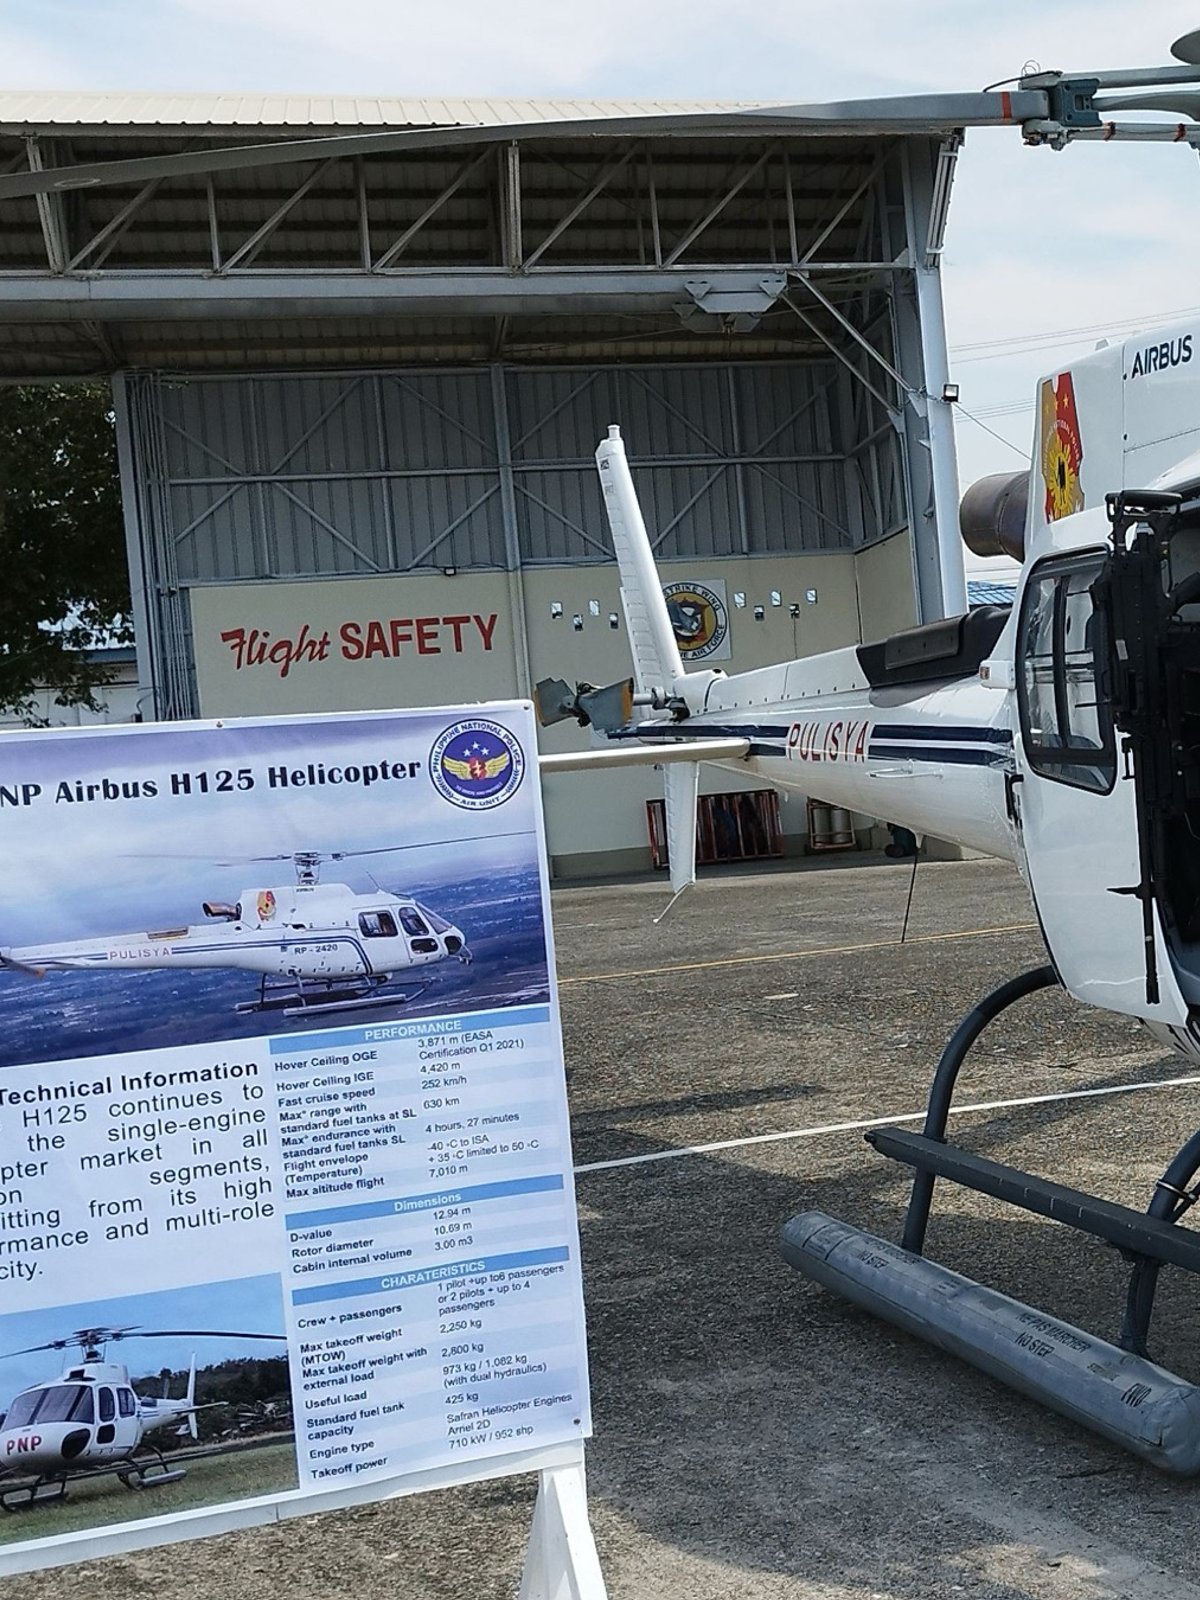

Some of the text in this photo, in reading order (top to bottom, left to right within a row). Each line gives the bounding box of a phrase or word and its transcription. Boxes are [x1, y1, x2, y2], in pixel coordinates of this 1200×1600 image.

[1131, 334, 1194, 378] AIRBUS
[220, 614, 498, 678] Flight SAFETY
[706, 625, 724, 650] FORCE
[461, 722, 502, 735] NATIONAL
[503, 734, 521, 766] POLICE
[788, 720, 869, 763] PULISYA
[55, 779, 158, 803] Airbus
[171, 768, 254, 796] H125
[268, 760, 421, 788] Helicopter
[110, 947, 170, 960] PULISYA
[365, 1020, 462, 1041] PERFORMANCE
[462, 1031, 493, 1044] (EASA
[420, 1039, 524, 1060] Certification 2021)
[275, 1051, 378, 1071] Hover Ceiling OGE
[0, 1062, 258, 1106] Technical Information
[276, 1072, 374, 1092] Hover Ceiling IGE
[422, 1076, 467, 1090] 252 km/h
[23, 1084, 264, 1128] H125 continues to
[278, 1088, 375, 1108] Fast cruise speed
[424, 1097, 460, 1109] 630 km
[310, 1102, 367, 1118] range with
[467, 1112, 519, 1127] 27 minutes
[27, 1107, 266, 1152] the single-engine
[281, 1108, 416, 1134] standard fuel tanks at SL
[312, 1124, 395, 1142] endurance with
[461, 1134, 489, 1146] to ISA
[80, 1144, 162, 1170] market
[192, 1138, 212, 1155] in
[243, 1129, 267, 1149] all
[283, 1135, 406, 1159] standard fuel tanks SL
[438, 1152, 450, 1162] 35
[467, 1145, 497, 1158] limited
[500, 1144, 509, 1153] to
[150, 1156, 270, 1185] segments,
[284, 1154, 368, 1172] Flight envelope
[285, 1165, 362, 1186] (Temperature)
[89, 1198, 142, 1218] from
[170, 1189, 197, 1206] its
[224, 1177, 272, 1200] high
[286, 1177, 384, 1198] Max altitude flight
[394, 1193, 461, 1211] Dimensions
[106, 1217, 148, 1240] and
[166, 1202, 274, 1231] multi-role
[463, 1222, 472, 1230] m
[291, 1229, 332, 1242] D-value
[458, 1236, 473, 1246] m3
[292, 1238, 374, 1258] Rotor diameter
[293, 1248, 412, 1274] Cabin internal volume
[381, 1261, 486, 1289] CHARATERISTICS
[446, 1265, 564, 1292] pilot passengers
[438, 1283, 521, 1303] or pilots up to
[298, 1305, 402, 1328] Crew passengers
[439, 1299, 495, 1316] passengers
[470, 1319, 482, 1329] kg
[300, 1329, 402, 1353] Max takeoff weight
[472, 1343, 484, 1353] kg
[1015, 1331, 1055, 1358] NO STEP
[301, 1350, 345, 1367] (MTOW)
[303, 1347, 427, 1378] Max takeoff weight with
[443, 1354, 527, 1375] 973 kg kg
[303, 1371, 374, 1391] external load
[444, 1362, 547, 1388] (with dual hydraulics)
[306, 1391, 367, 1409] Useful load
[445, 1392, 478, 1404] 425 kg
[307, 1401, 405, 1428] Standard fuel tank
[447, 1394, 572, 1423] Safran Helicopter Engines
[308, 1425, 354, 1440] capacity
[477, 1419, 491, 1429] 2D
[6, 1435, 42, 1455] PNP
[309, 1440, 375, 1459] Engine type
[449, 1438, 468, 1449] 710
[471, 1434, 486, 1444] kW
[312, 1457, 388, 1479] Takeoff power
